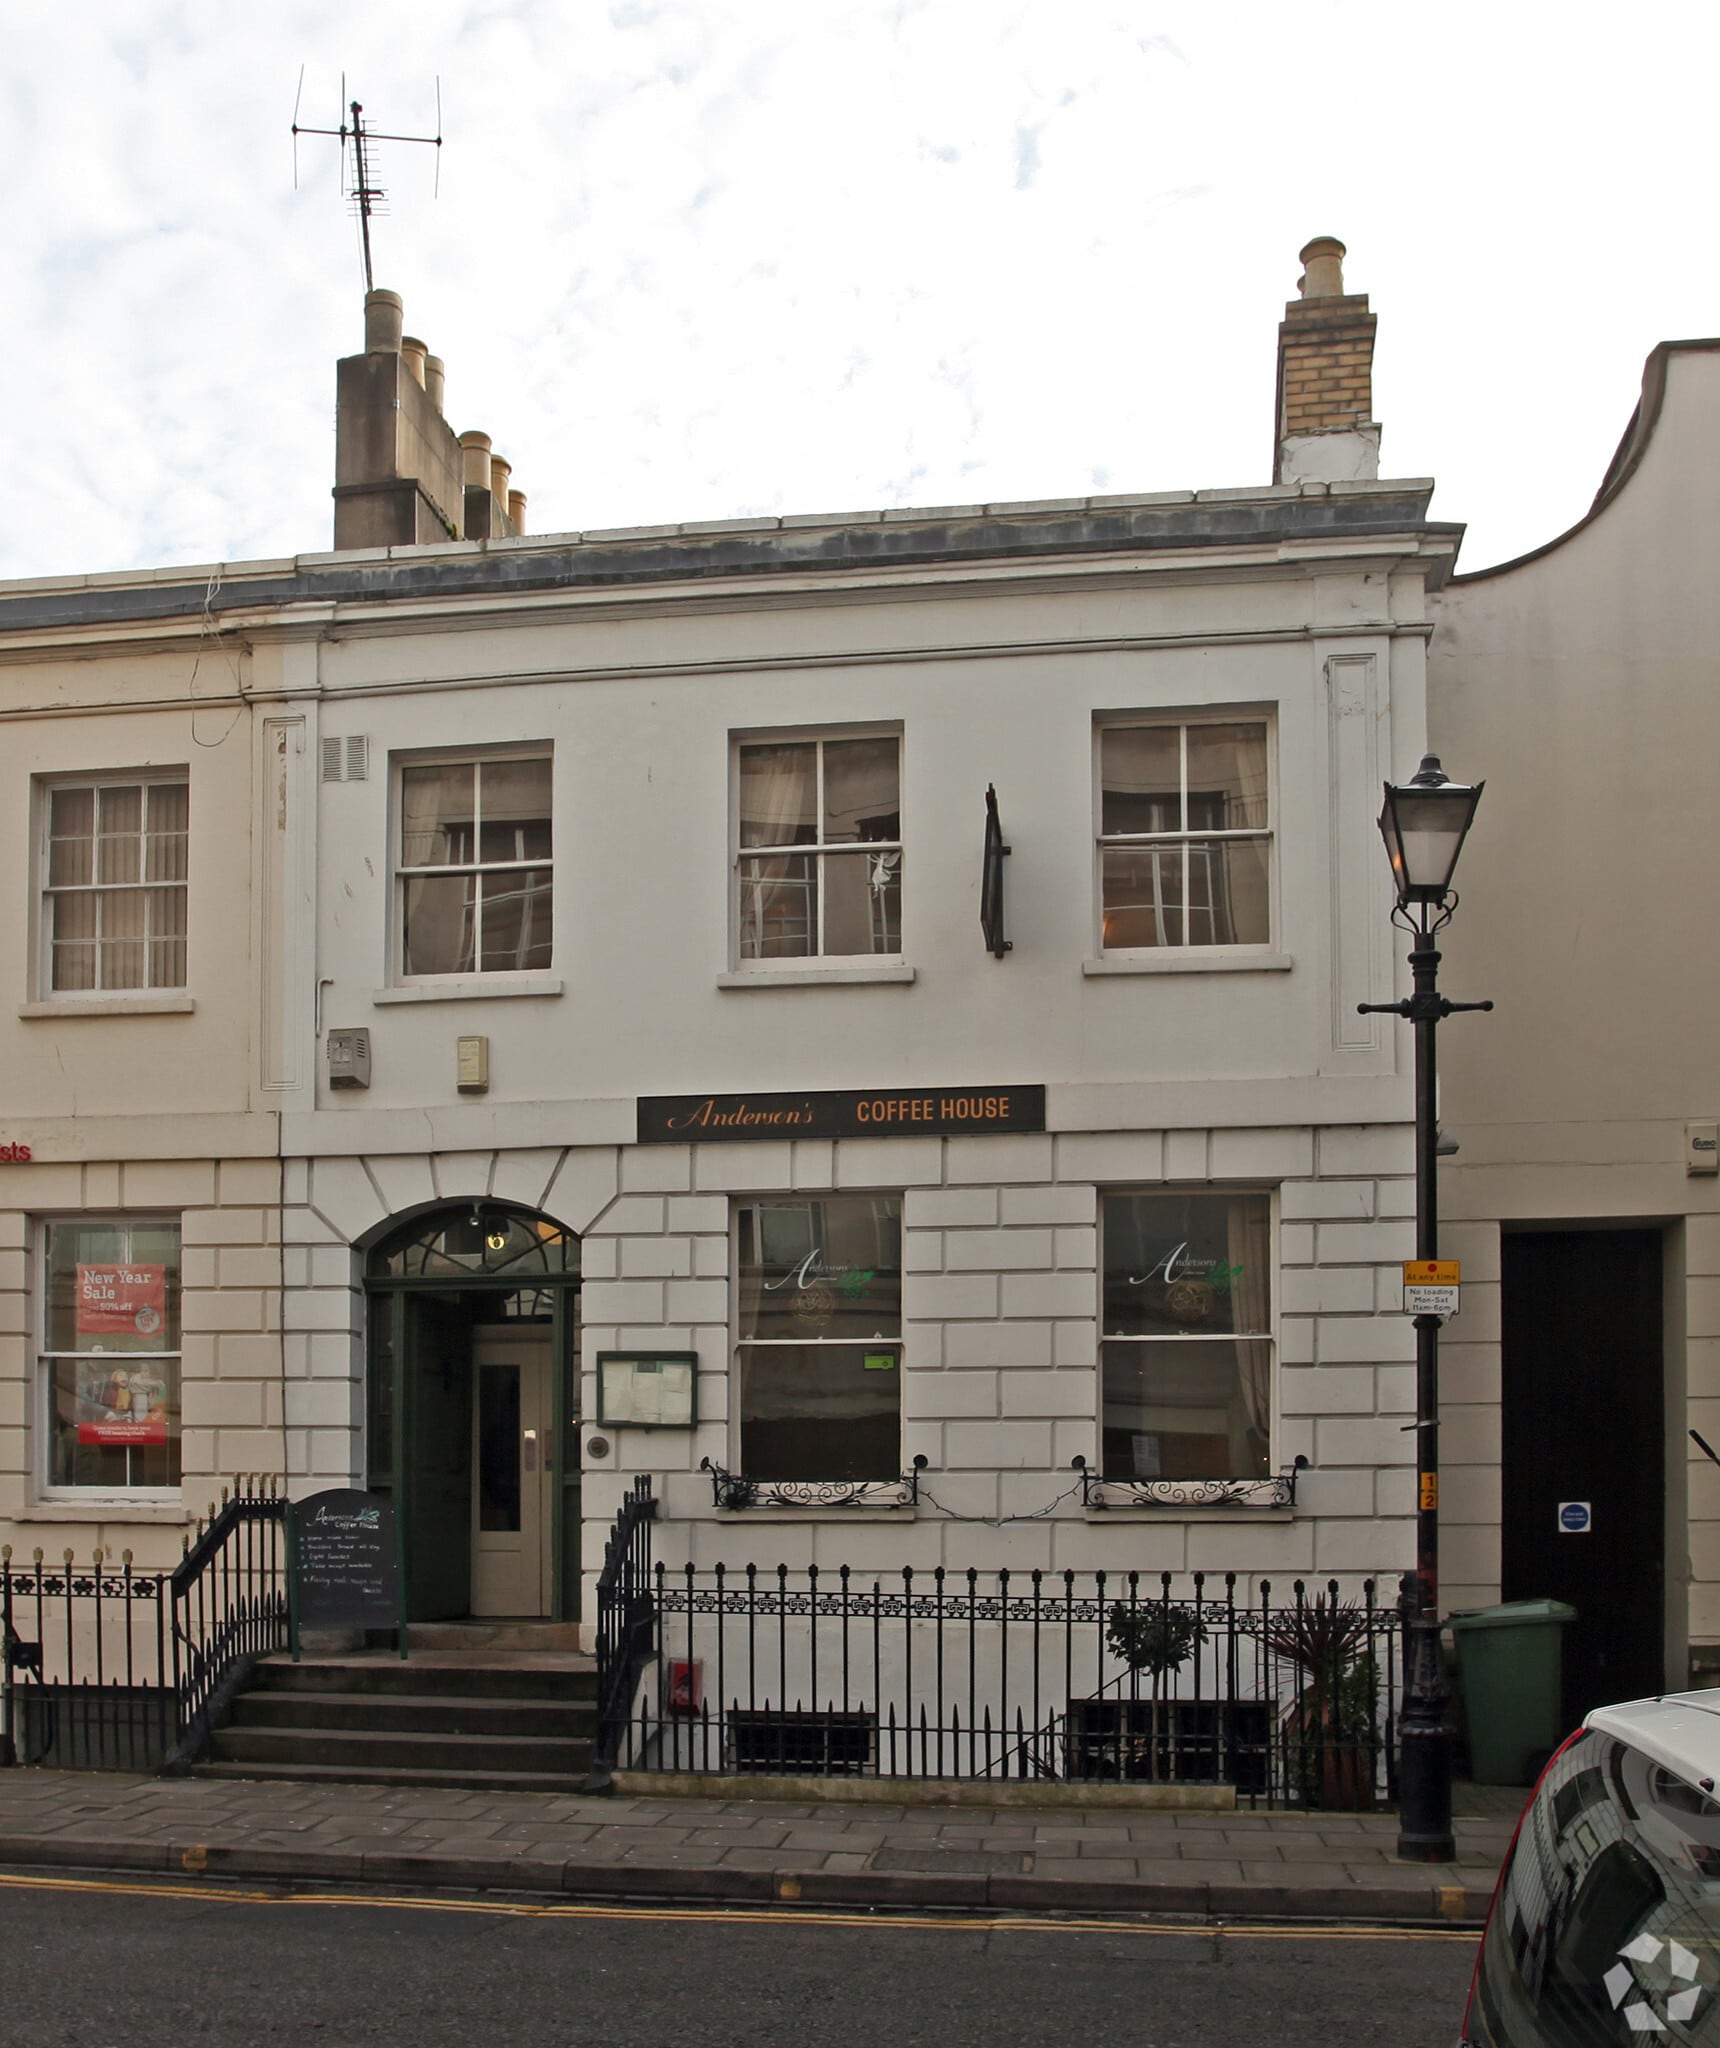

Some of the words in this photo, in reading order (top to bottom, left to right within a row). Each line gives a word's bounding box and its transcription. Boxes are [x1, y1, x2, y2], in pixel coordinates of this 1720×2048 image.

[667, 1099, 815, 1129] Anderson's
[856, 1099, 934, 1122] COFFEE
[940, 1096, 1010, 1120] HOUSE
[83, 1270, 116, 1284] New
[117, 1269, 152, 1284] Year
[1406, 1273, 1417, 1281] At
[1437, 1273, 1457, 1281] time
[83, 1285, 116, 1300] Sale
[1423, 1288, 1454, 1296] loading
